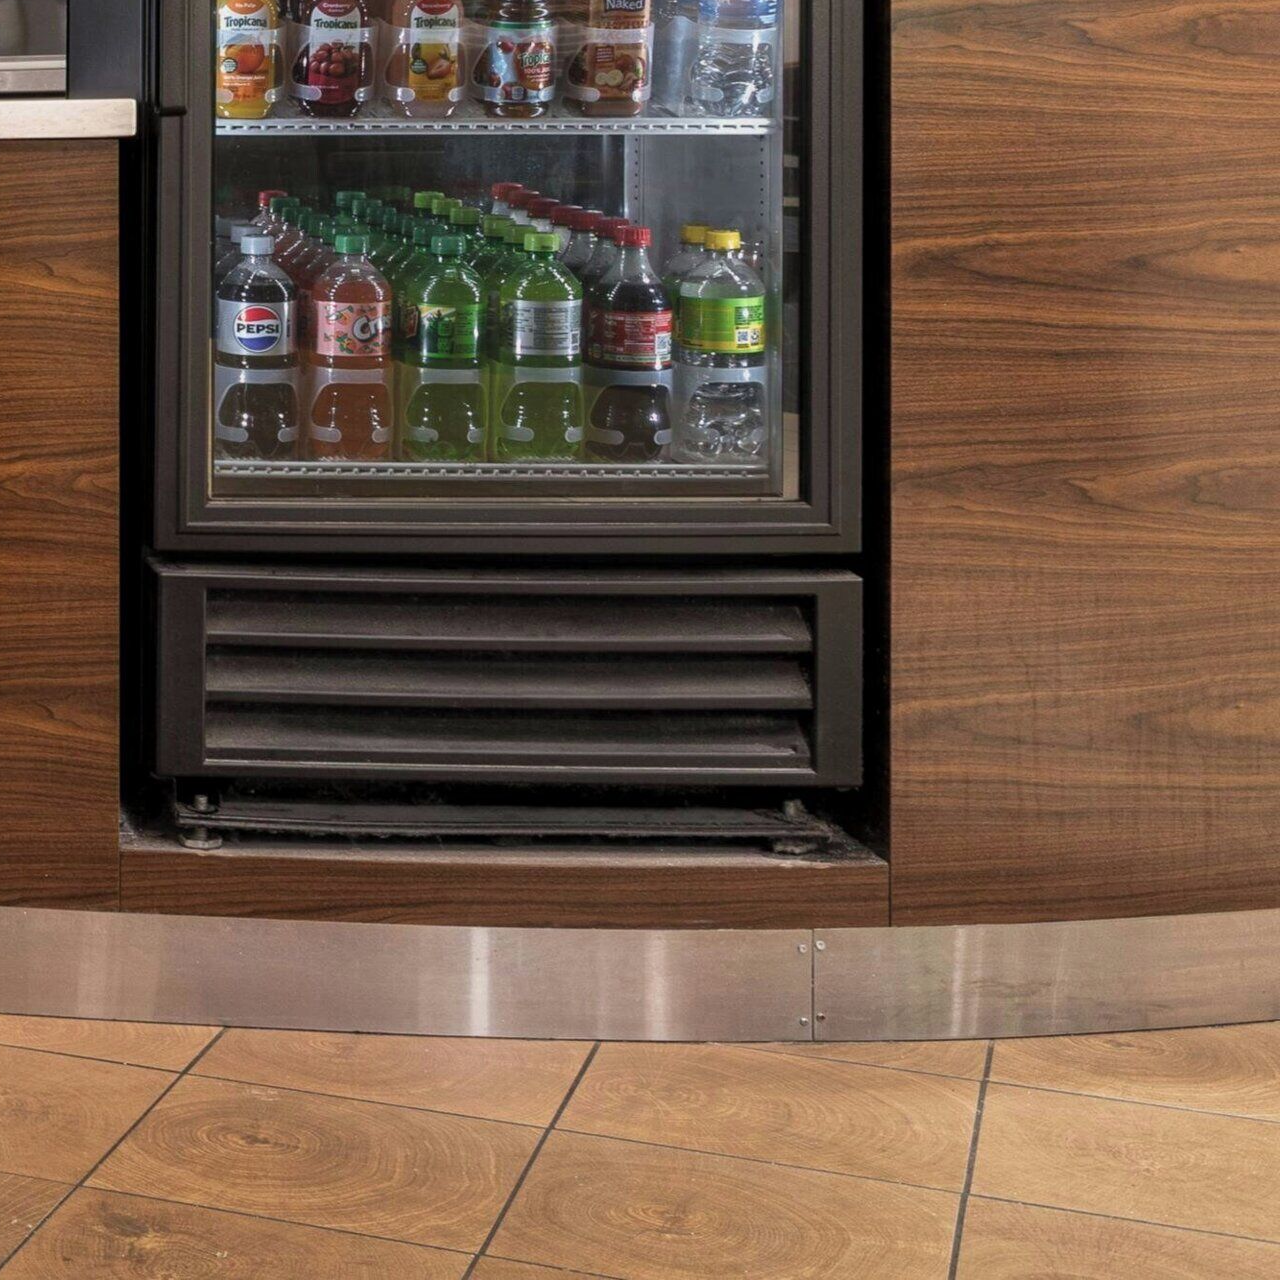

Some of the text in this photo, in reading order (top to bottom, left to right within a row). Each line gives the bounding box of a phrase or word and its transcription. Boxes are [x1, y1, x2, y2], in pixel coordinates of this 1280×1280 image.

[224, 16, 267, 28] Tropicana
[314, 18, 358, 29] Tropicana
[414, 16, 456, 30] Tropicana
[236, 324, 279, 334] PEPSI
